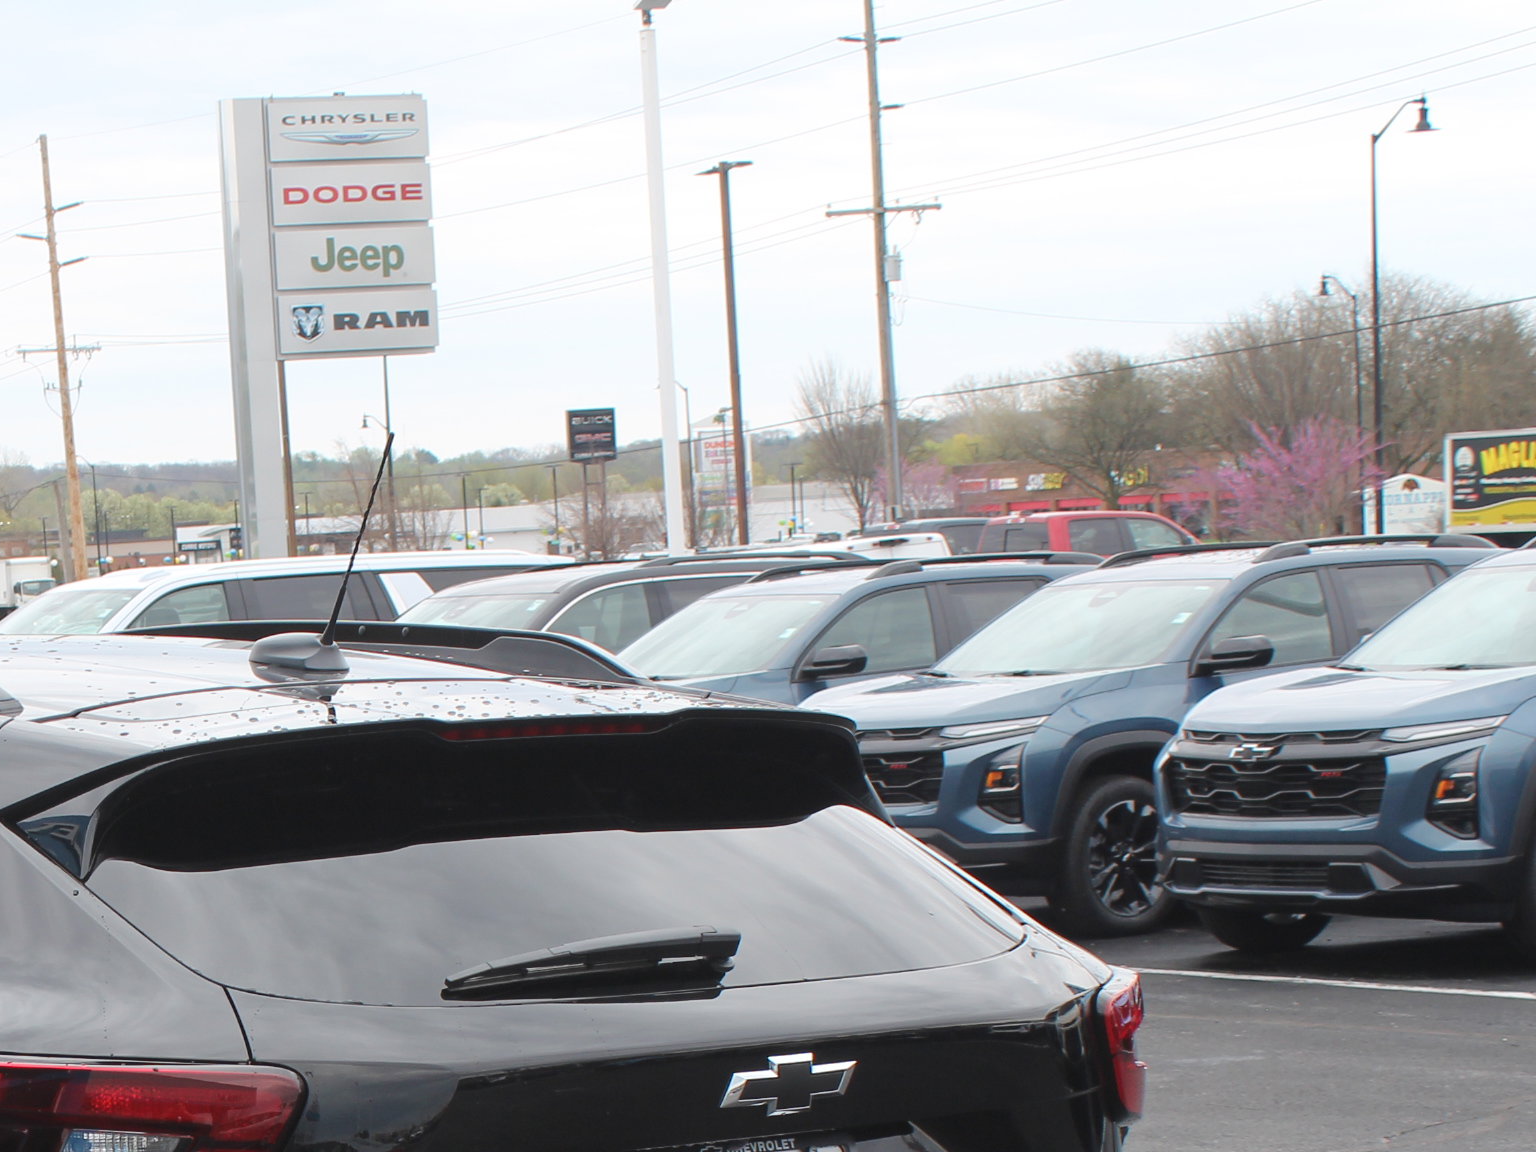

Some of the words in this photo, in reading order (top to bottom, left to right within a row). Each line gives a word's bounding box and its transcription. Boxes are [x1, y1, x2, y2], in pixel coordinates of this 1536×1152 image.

[281, 112, 416, 126] CHRYSLER
[282, 183, 424, 205] DODGE
[310, 237, 404, 278] Jeep
[333, 310, 430, 331] RAM
[571, 415, 613, 425] BUICK
